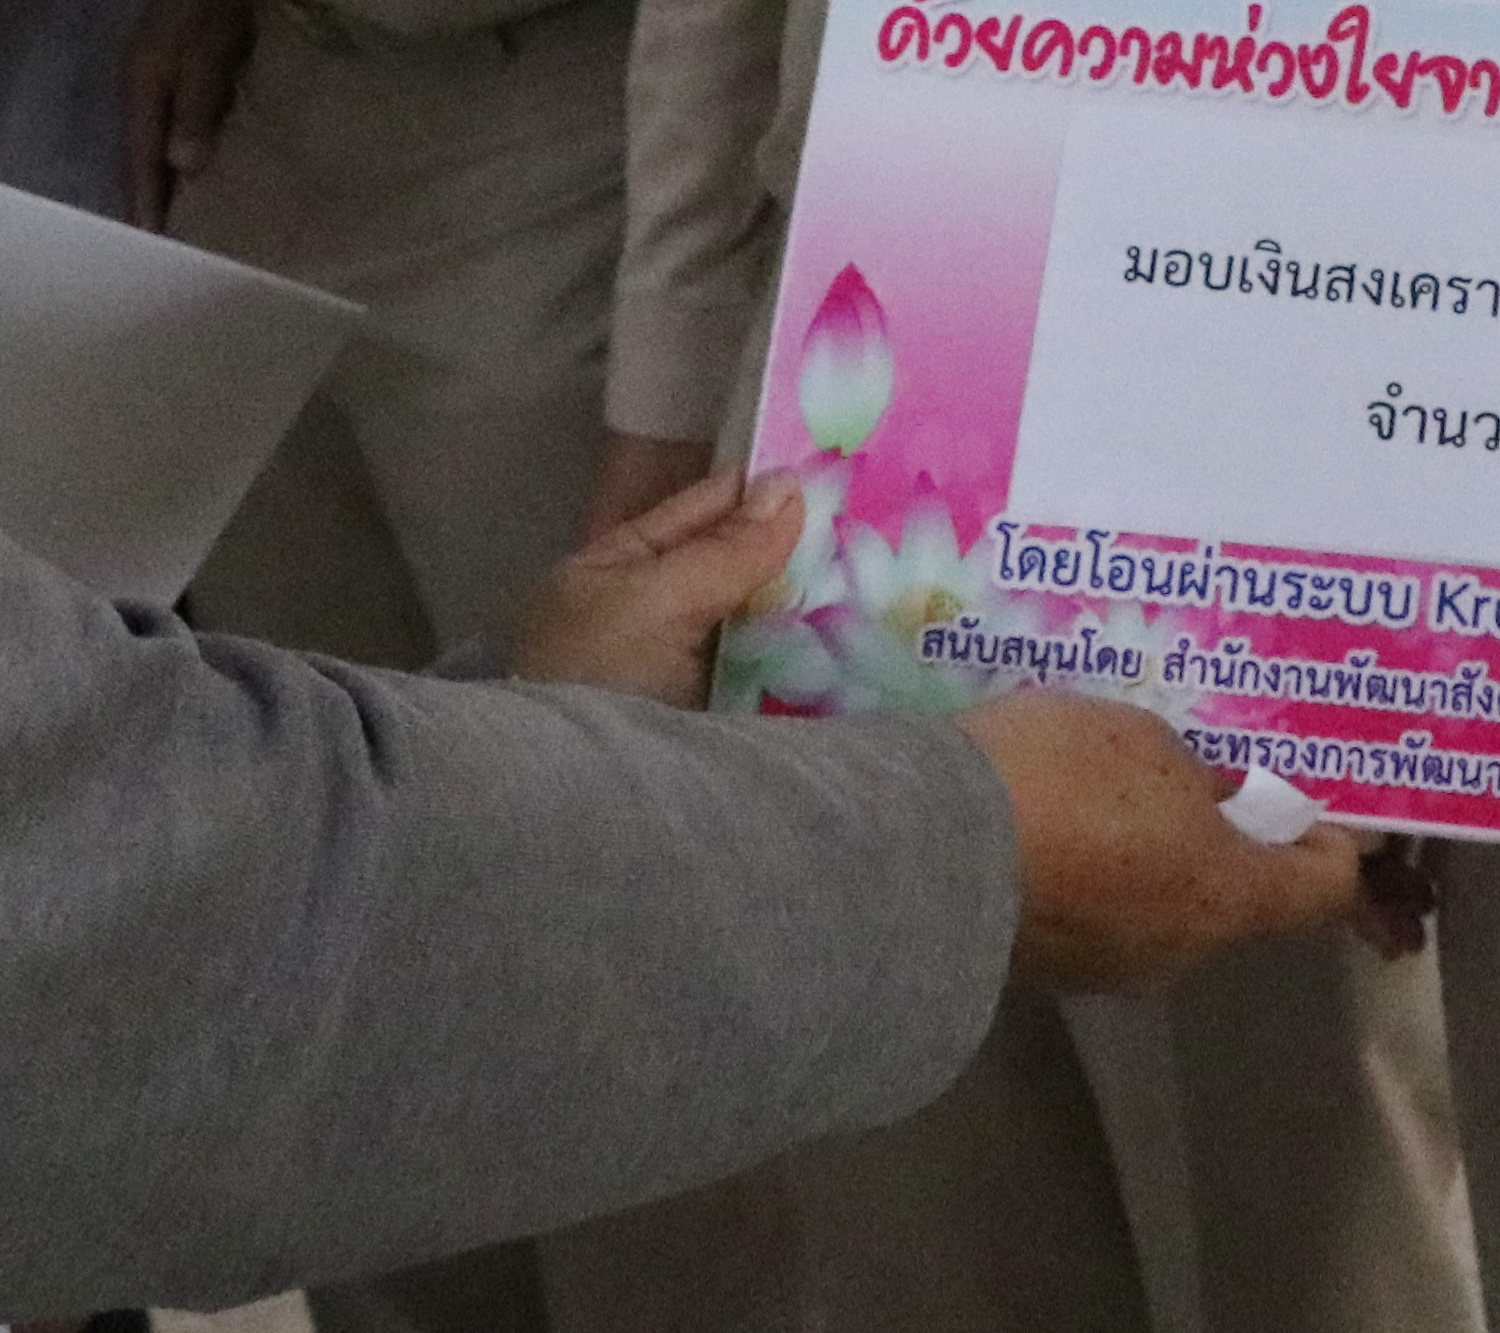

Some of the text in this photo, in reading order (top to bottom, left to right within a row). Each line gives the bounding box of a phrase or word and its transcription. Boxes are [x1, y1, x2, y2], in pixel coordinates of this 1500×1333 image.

[995, 521, 1412, 622] โดยโอนผ่านระบบ
[920, 616, 1142, 683] สนับสนุนโดย
